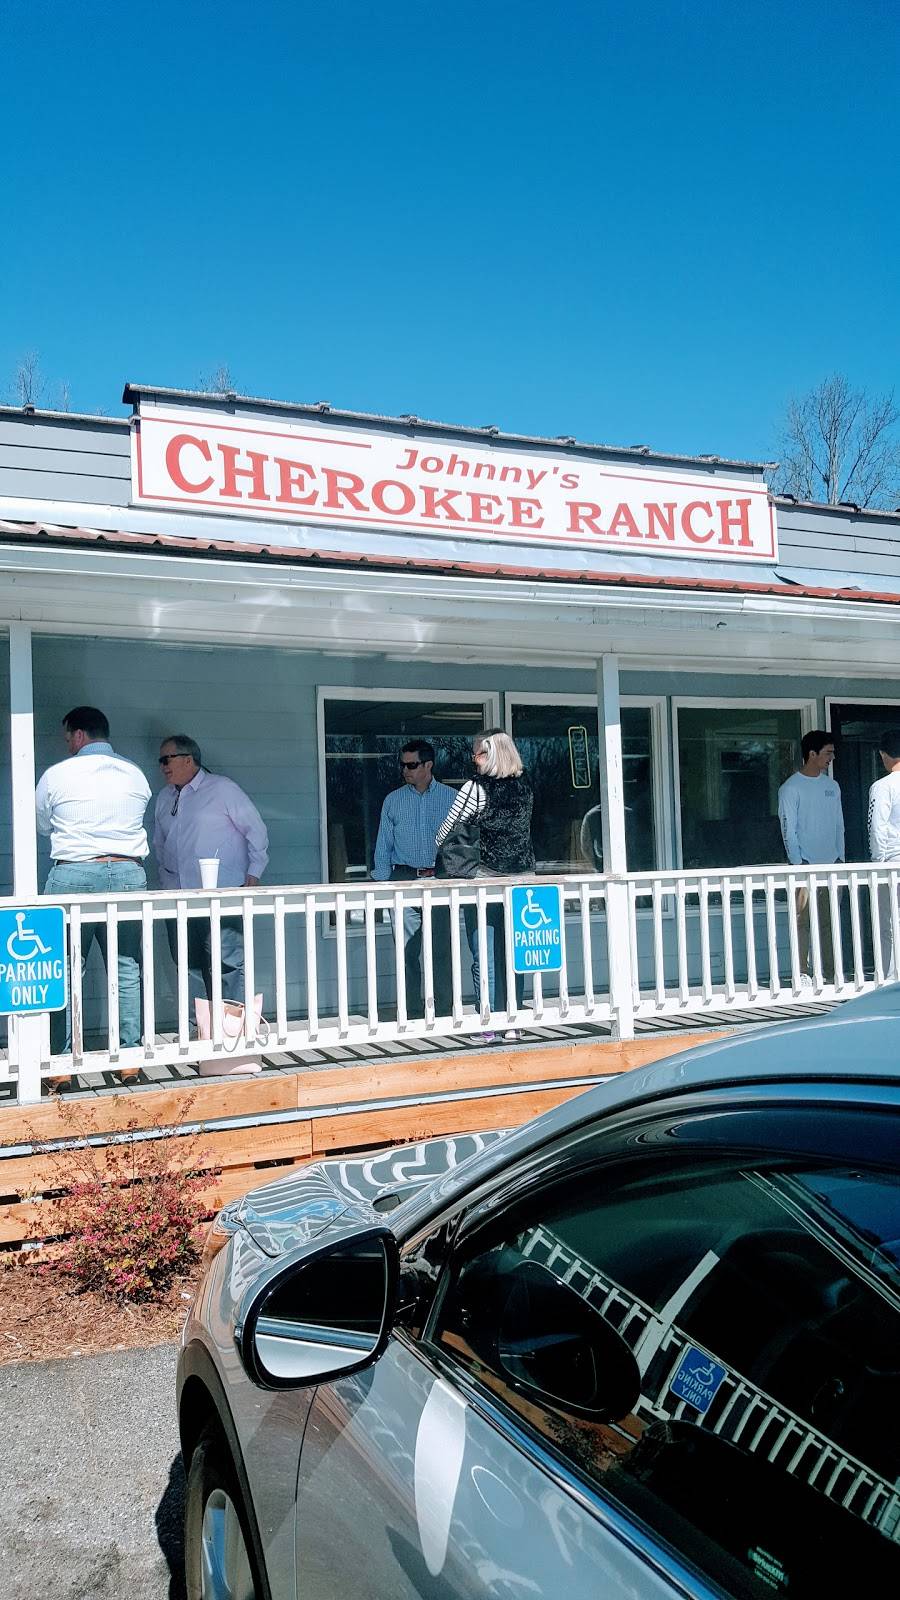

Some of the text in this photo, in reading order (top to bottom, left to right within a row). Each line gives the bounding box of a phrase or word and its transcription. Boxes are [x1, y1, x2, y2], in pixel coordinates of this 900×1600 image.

[396, 448, 580, 490] Johnny's
[165, 433, 754, 547] CHEROKEE RANCH
[514, 928, 560, 947] PARKING
[525, 949, 551, 967] ONLY
[0, 959, 63, 982] PARKING
[11, 984, 49, 1006] ONLY
